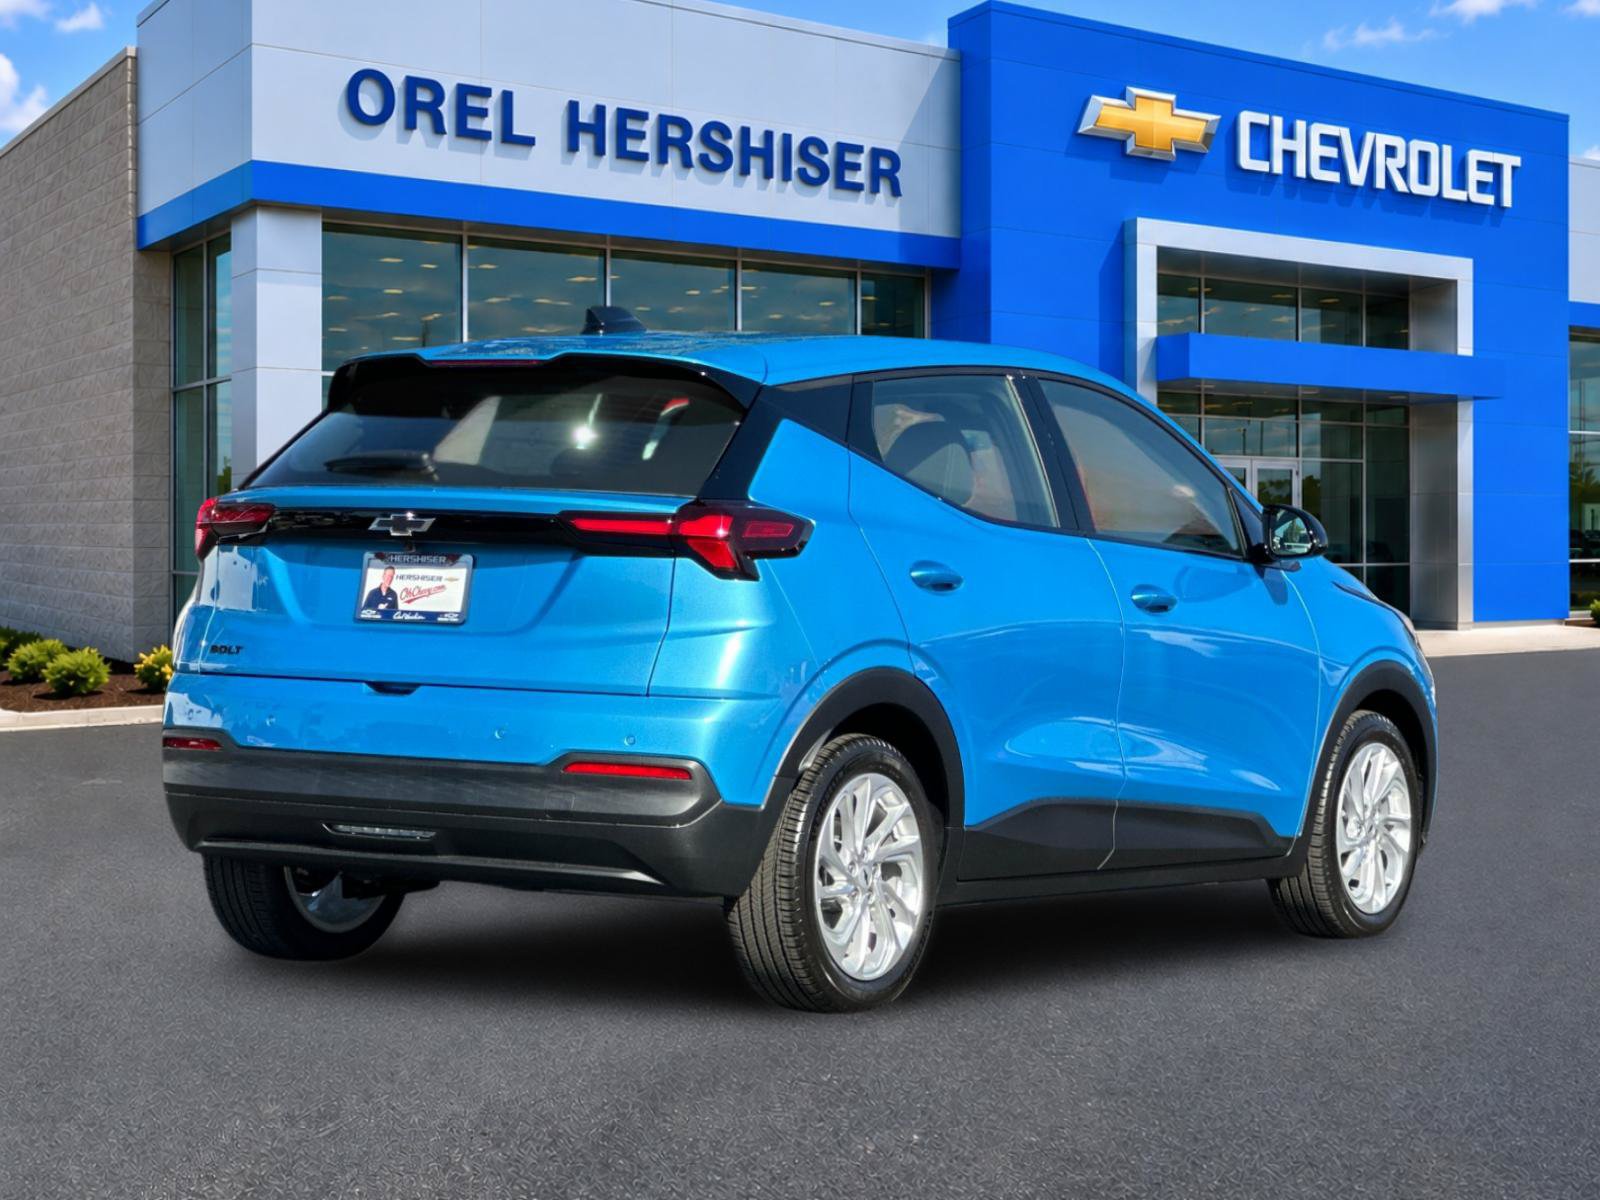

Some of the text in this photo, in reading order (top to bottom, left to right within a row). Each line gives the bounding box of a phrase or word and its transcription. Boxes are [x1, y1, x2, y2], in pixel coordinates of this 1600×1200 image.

[345, 68, 902, 198] OREL HERSHISER
[1237, 110, 1522, 208] CHEVROLET
[390, 554, 447, 563] HERSHISER
[395, 574, 443, 582] HERSHISER
[210, 645, 243, 654] BOLT
